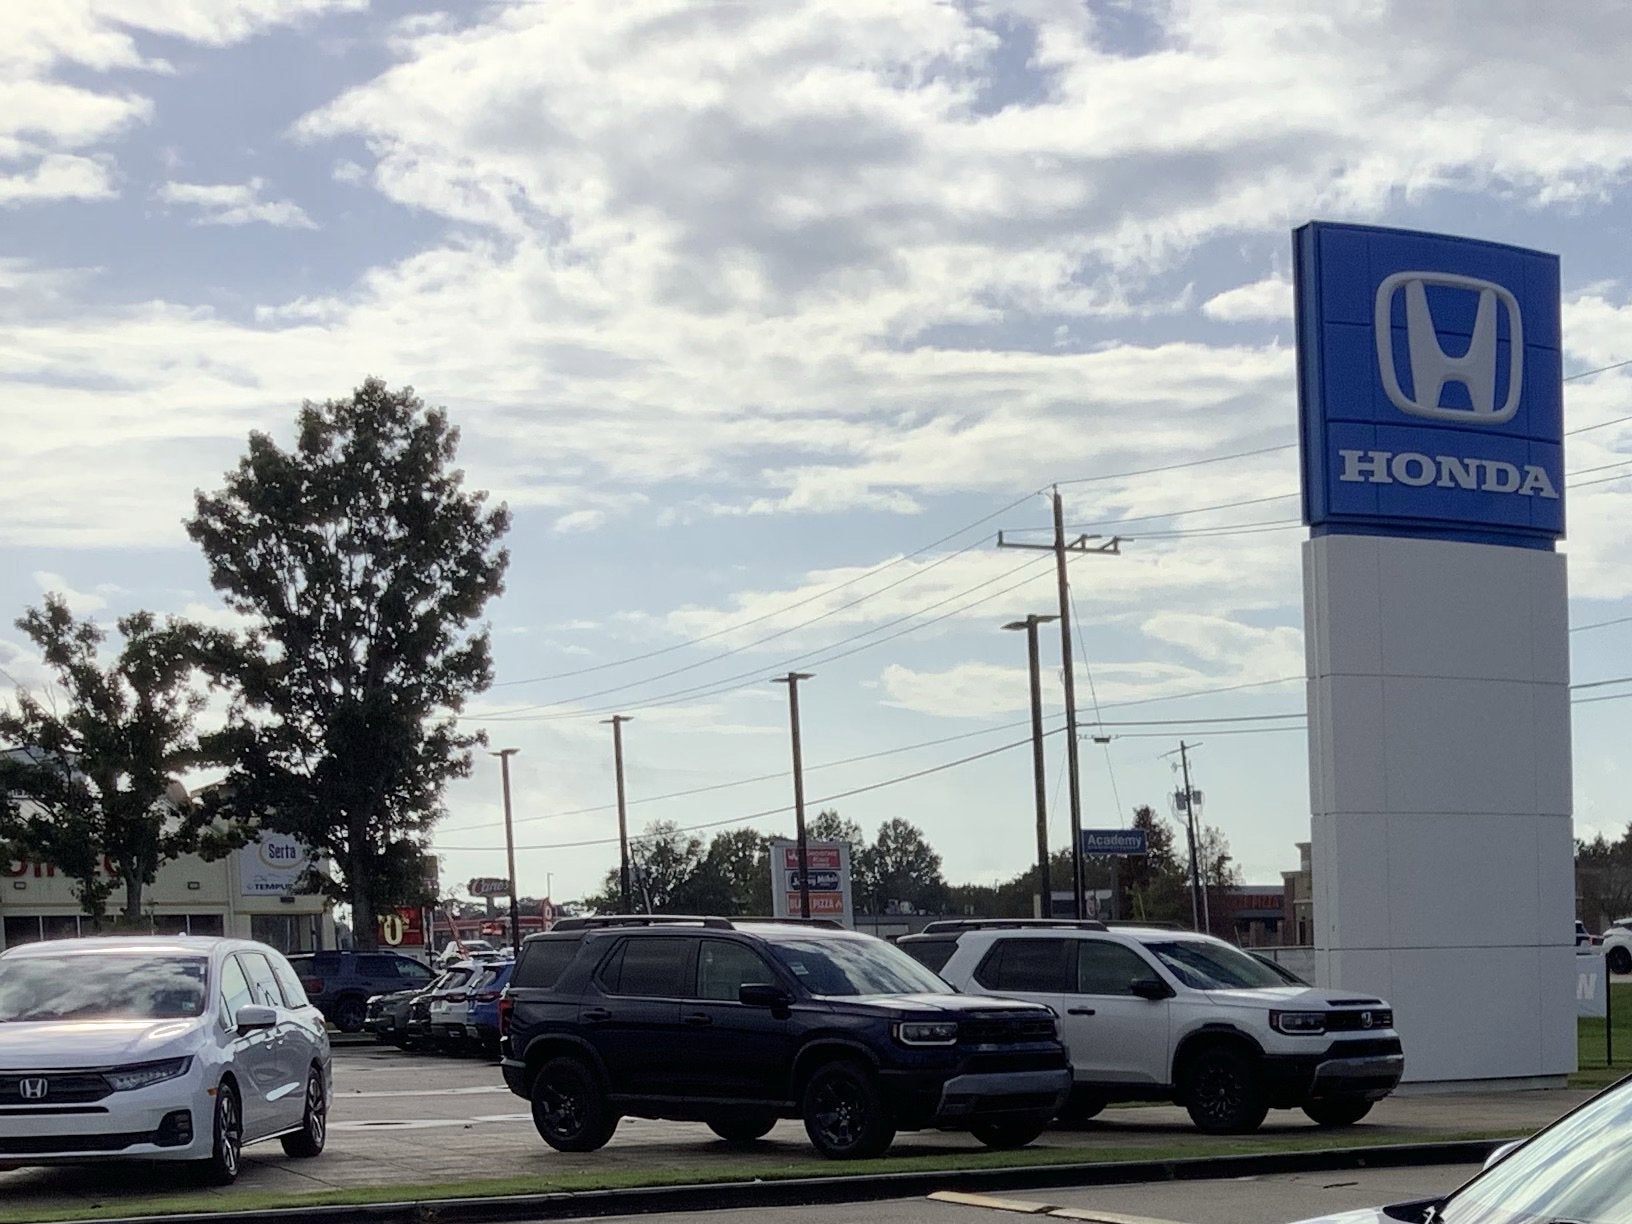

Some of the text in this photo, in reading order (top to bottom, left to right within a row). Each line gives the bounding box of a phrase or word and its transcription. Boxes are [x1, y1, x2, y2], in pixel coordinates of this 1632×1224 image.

[1338, 450, 1560, 499] HONDA
[1087, 834, 1142, 849] Academy
[268, 843, 297, 859] Serta
